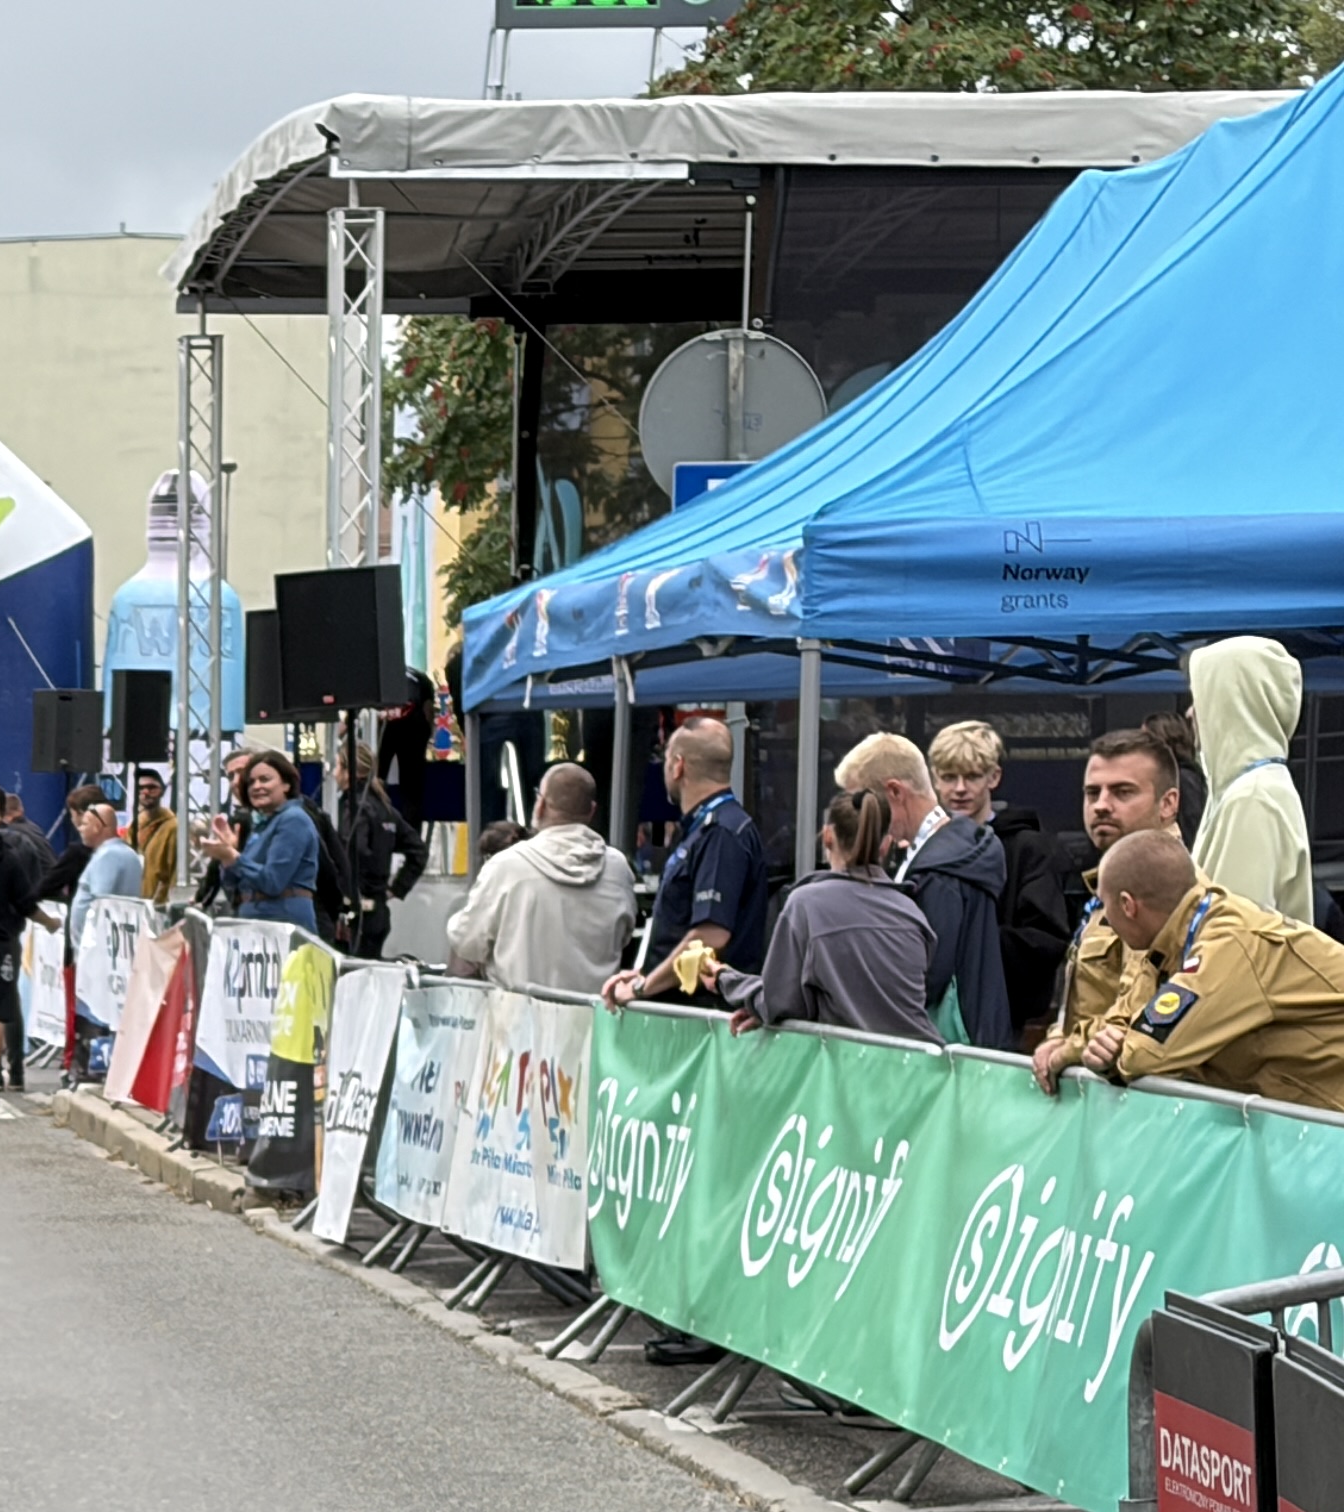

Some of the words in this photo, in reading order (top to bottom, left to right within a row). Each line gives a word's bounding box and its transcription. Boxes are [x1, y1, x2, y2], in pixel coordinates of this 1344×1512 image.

[1002, 563, 1091, 584] Norway
[1001, 592, 1069, 613] grants
[1159, 1427, 1252, 1507] DATASPORT
